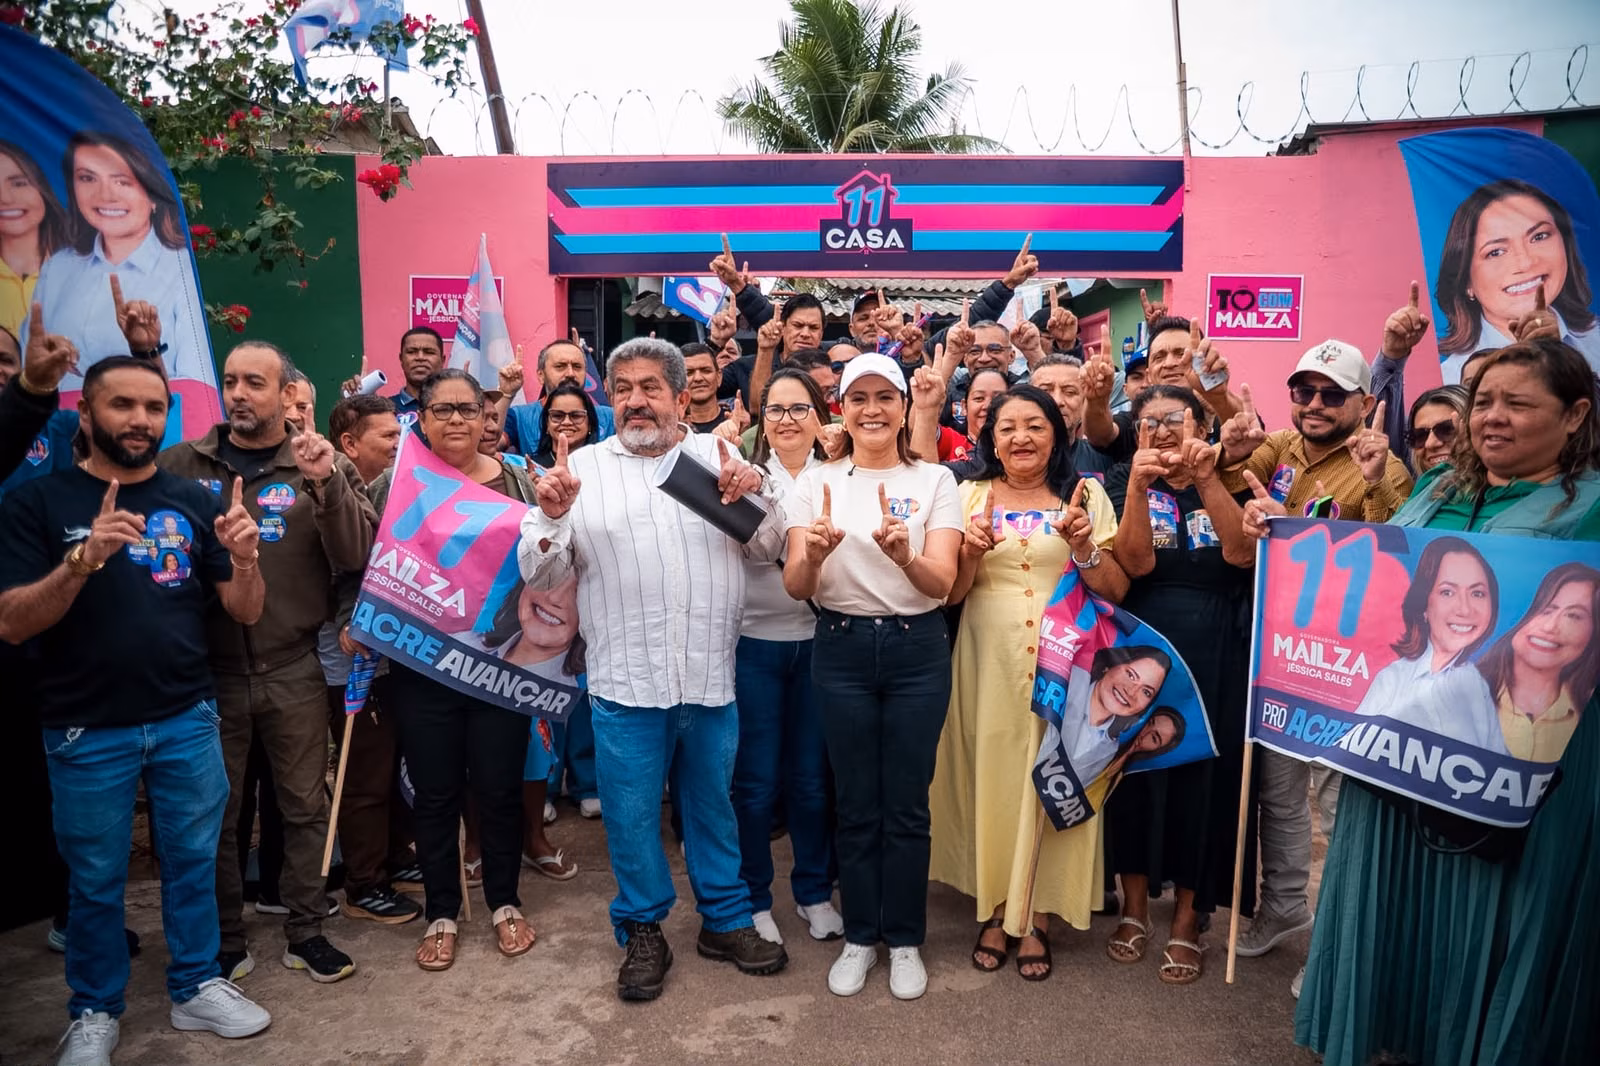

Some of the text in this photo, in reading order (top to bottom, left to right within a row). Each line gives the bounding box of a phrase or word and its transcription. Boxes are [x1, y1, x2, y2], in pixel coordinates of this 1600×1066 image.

[844, 185, 886, 227] 11
[826, 228, 905, 249] CASA
[1258, 291, 1293, 308] COM
[1216, 312, 1293, 329] MAILZA
[391, 466, 511, 570] 11
[1015, 514, 1033, 529] 11
[1289, 528, 1375, 639] 11
[408, 591, 444, 617] SALES
[352, 602, 444, 666] ACRE
[436, 648, 572, 715] AVANÇAR
[1273, 633, 1370, 680] MAILZA
[1324, 671, 1352, 687] SALES
[1033, 675, 1067, 721] CR
[1262, 702, 1288, 729] PRO
